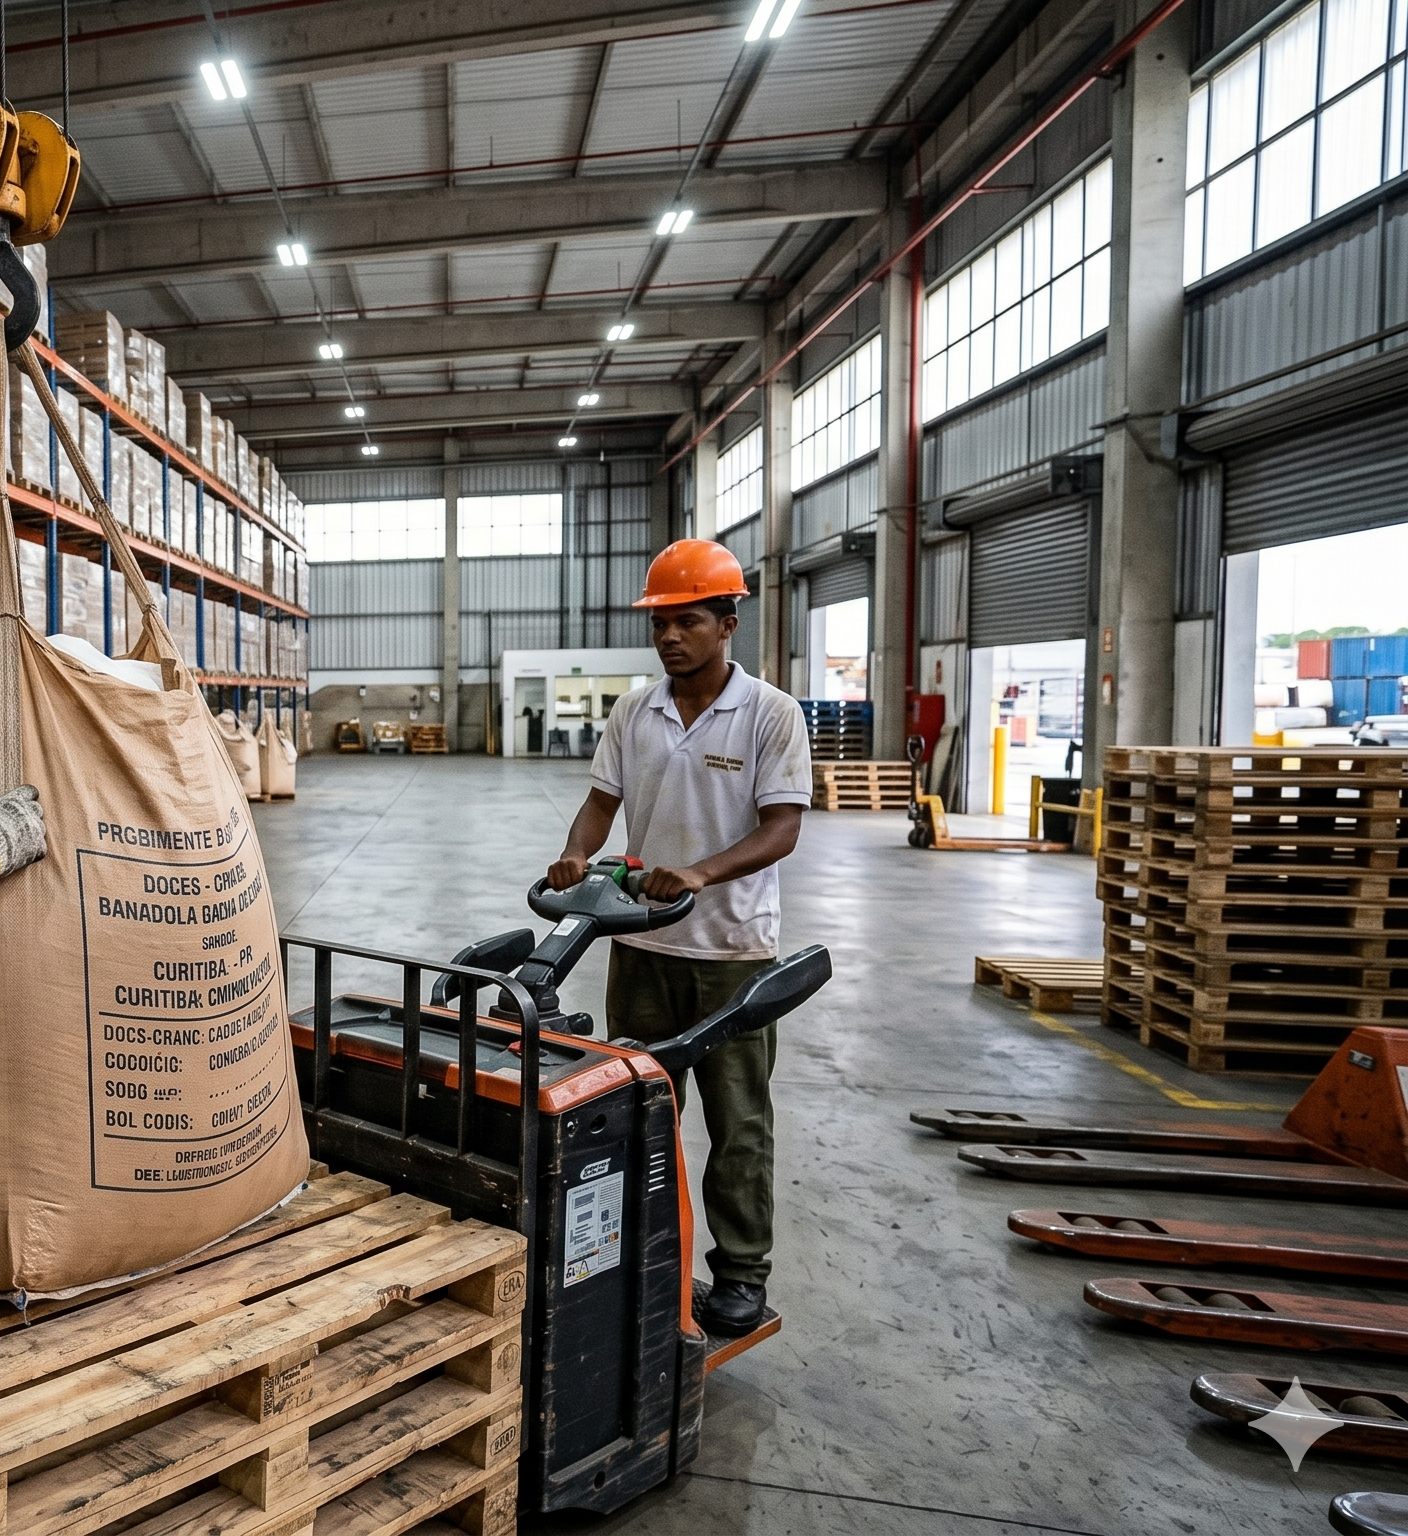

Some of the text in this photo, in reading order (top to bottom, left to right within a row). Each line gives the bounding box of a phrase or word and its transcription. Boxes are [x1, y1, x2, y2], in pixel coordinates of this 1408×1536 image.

[143, 873, 202, 896] DOCES
[98, 896, 199, 925] BANADOLA
[106, 1109, 138, 1128] BOL
